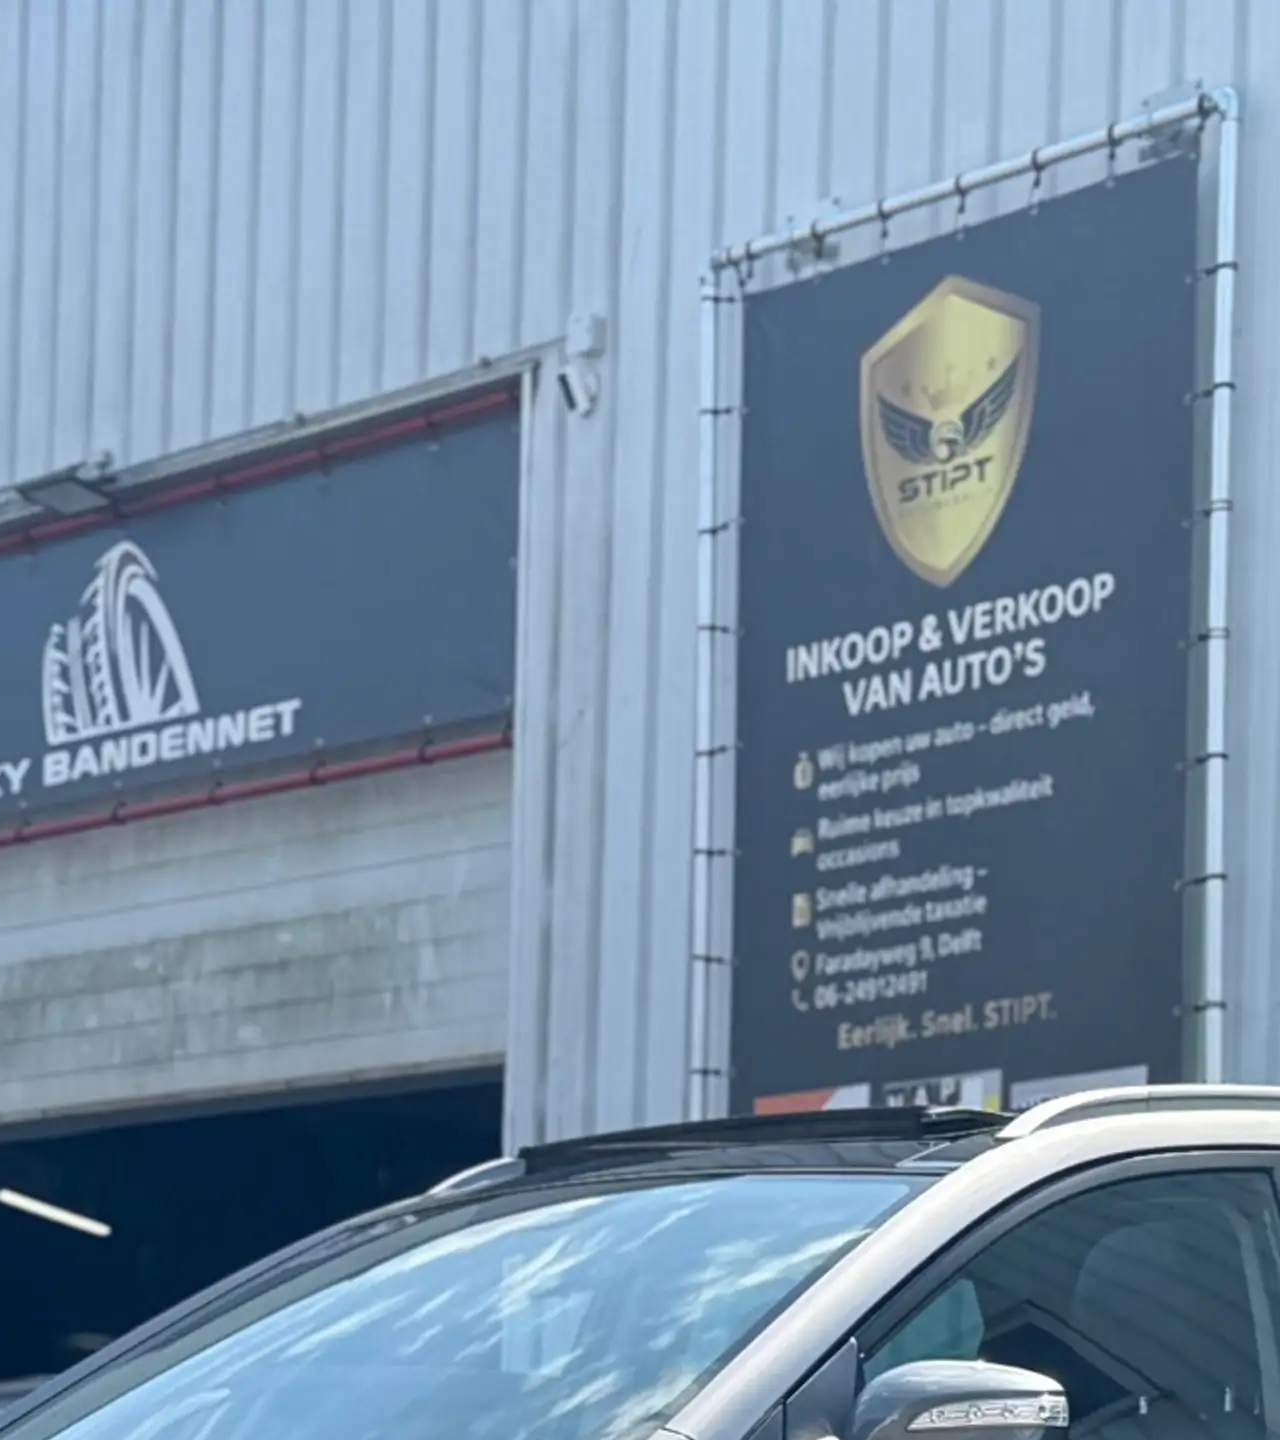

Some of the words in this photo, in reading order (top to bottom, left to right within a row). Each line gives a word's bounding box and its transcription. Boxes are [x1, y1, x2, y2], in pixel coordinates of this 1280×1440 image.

[897, 455, 994, 505] STIPT
[785, 621, 914, 684] INKOOP
[917, 613, 943, 653] &
[947, 572, 1116, 644] VERKOOP
[842, 668, 913, 717] VAN
[918, 637, 1047, 702] AUTO'S
[42, 697, 302, 788] BANDENNET
[934, 721, 975, 747] auto
[989, 704, 1045, 735] direct
[817, 838, 901, 873] occasions
[937, 927, 983, 957] Delft
[837, 1013, 917, 1050] Eerlijk.
[921, 1004, 978, 1038] Snel.
[983, 992, 1058, 1030] STIPT.
